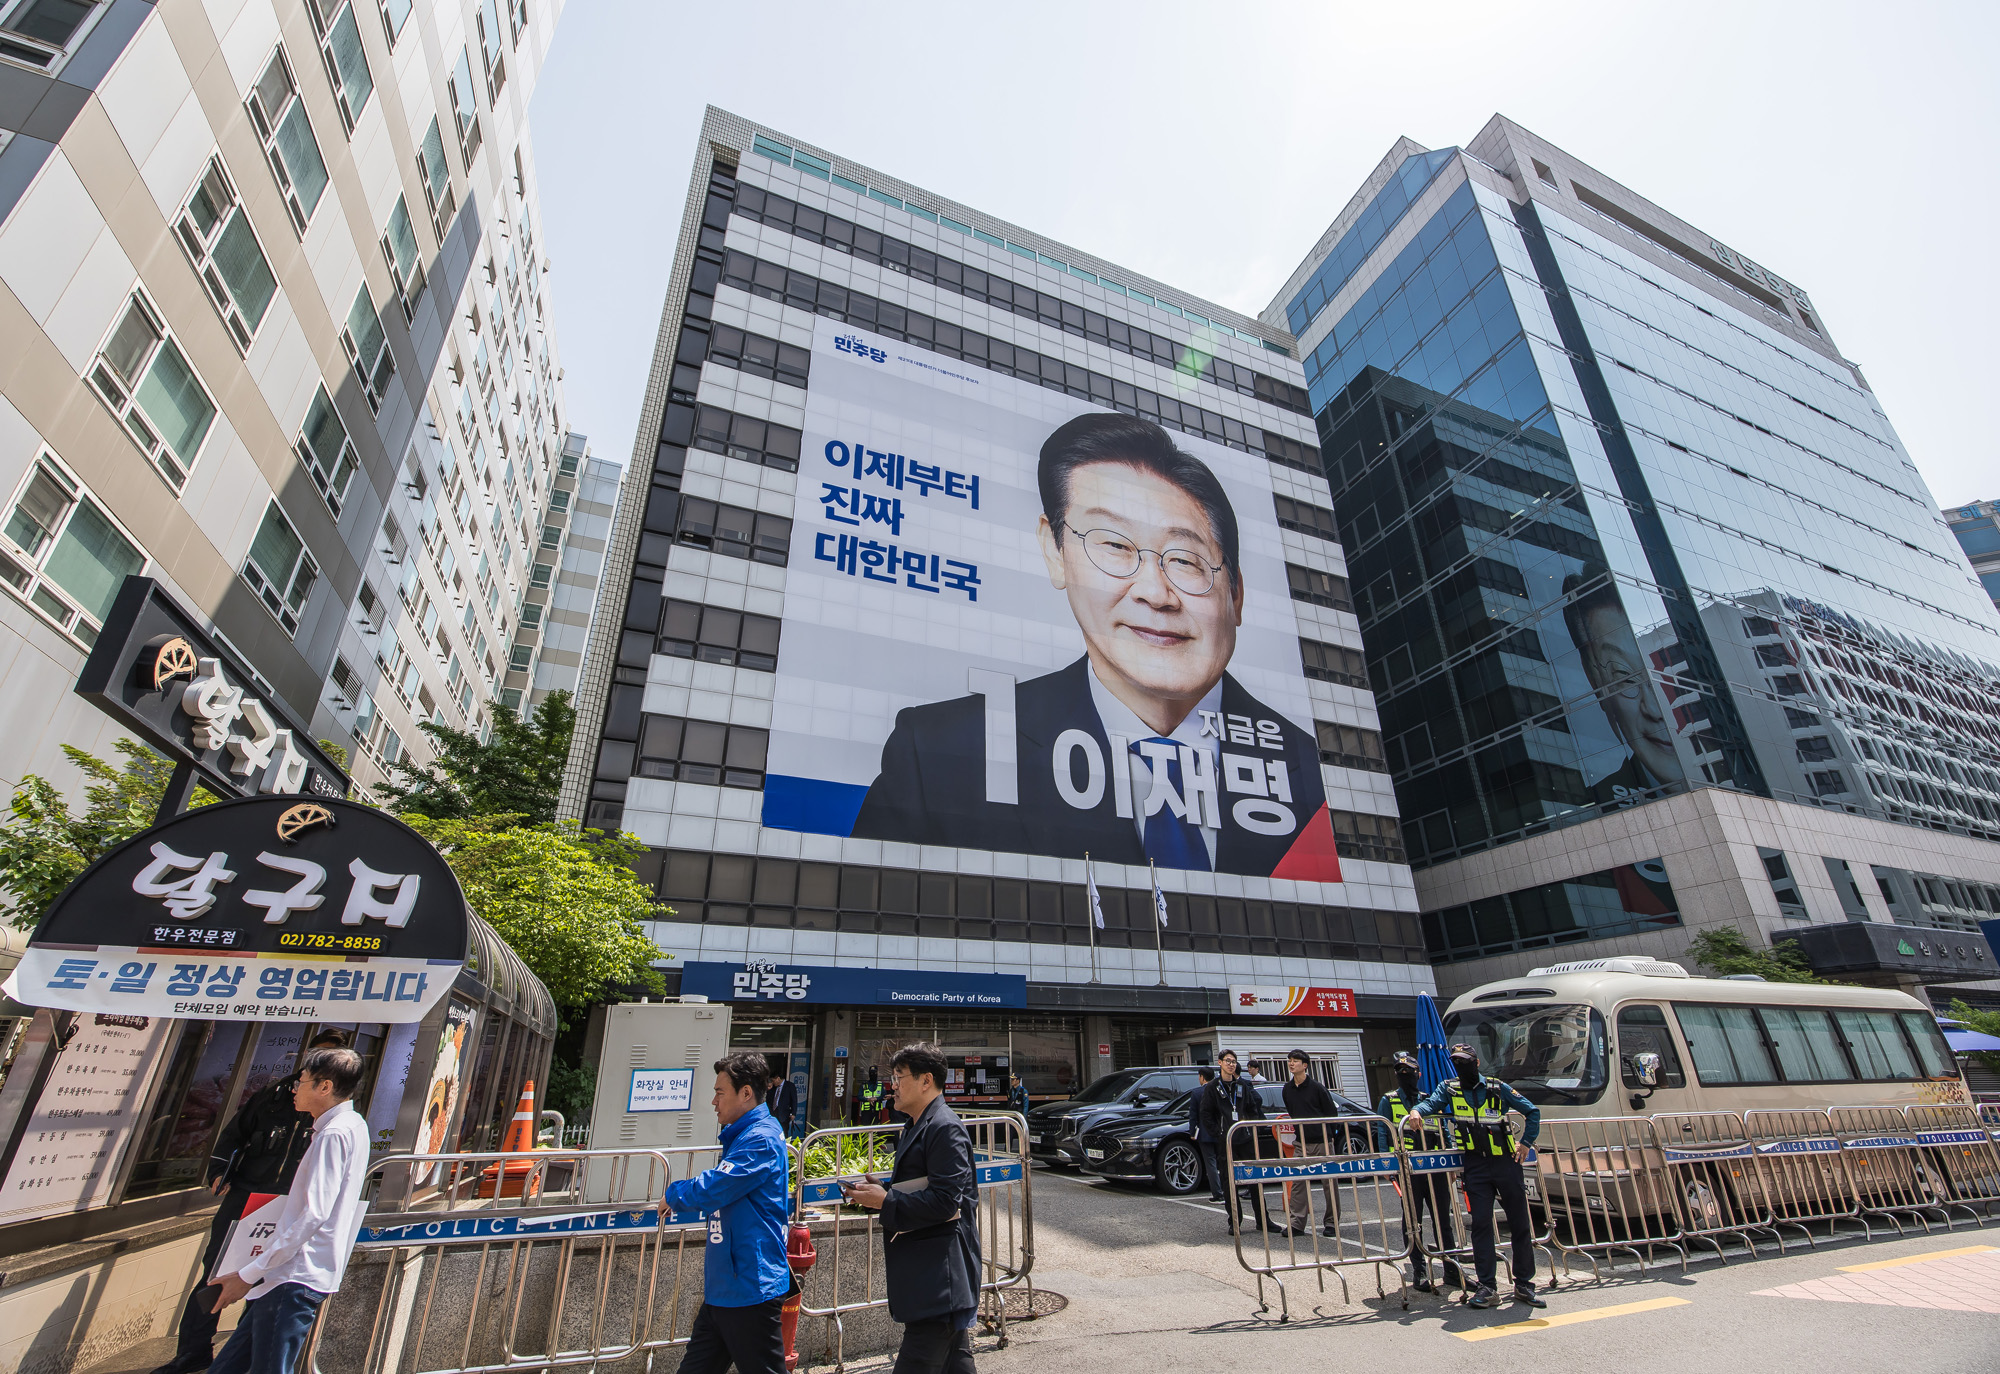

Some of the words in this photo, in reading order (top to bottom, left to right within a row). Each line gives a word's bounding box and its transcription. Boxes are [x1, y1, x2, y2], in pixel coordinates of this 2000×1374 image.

[834, 336, 888, 364] 민주당
[824, 440, 980, 510] 이제부터
[819, 482, 905, 537] 진짜
[814, 532, 982, 602] 대한민국
[1197, 709, 1284, 751] 지금은
[968, 666, 1019, 805] 1
[1052, 728, 1297, 836] 이재명
[132, 841, 421, 929] 달구지
[153, 925, 238, 946] 한우전문점
[279, 932, 382, 951] 02)782-8858
[745, 958, 778, 975] 더불어
[46, 957, 157, 994] 토·일
[166, 963, 248, 998] 정상
[256, 966, 429, 1003] 영업합니다
[733, 972, 811, 1000] 민주당
[891, 991, 940, 1002] Democratic
[942, 993, 965, 1004] Party
[967, 994, 976, 1002] of
[977, 994, 1001, 1003] Korea
[1317, 1000, 1349, 1012] 우체국
[173, 1001, 230, 1017] 단체모임
[233, 1003, 261, 1016] 예약
[264, 1004, 319, 1018] 받습니다.
[635, 1080, 664, 1092] 화장실
[669, 1079, 689, 1091] 안내
[834, 1068, 845, 1098] 민주당
[1806, 1141, 1829, 1151] LINE
[1925, 1133, 1957, 1143] POLICE
[1959, 1132, 1979, 1141] LINE
[1338, 1159, 1377, 1172] LINE
[401, 1217, 527, 1239] POLICE
